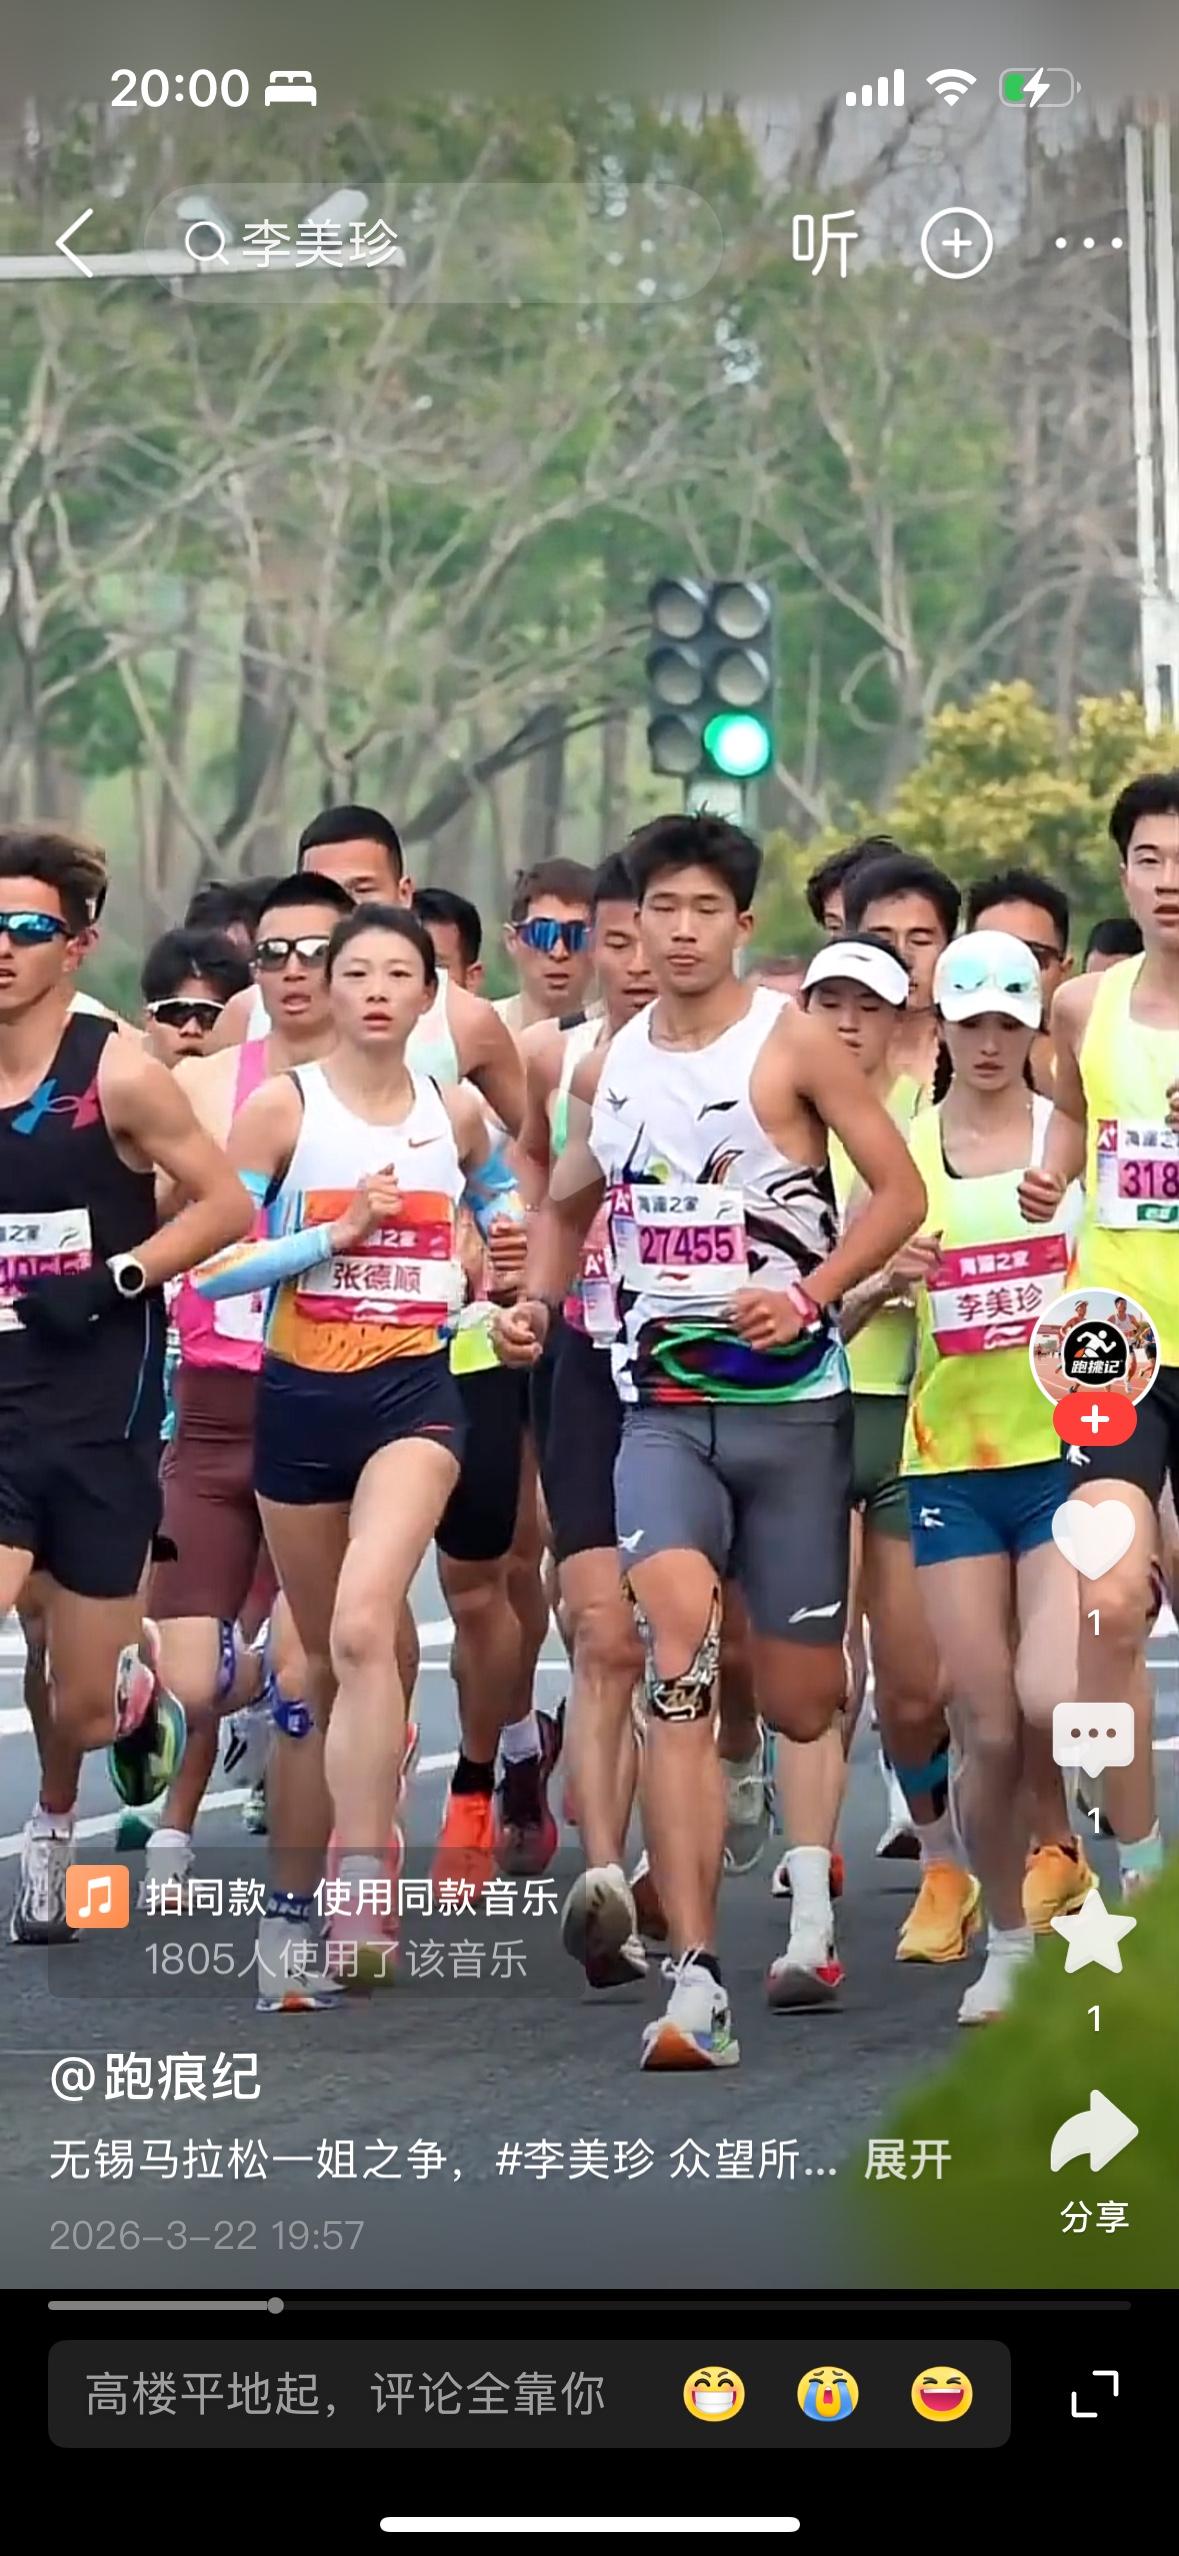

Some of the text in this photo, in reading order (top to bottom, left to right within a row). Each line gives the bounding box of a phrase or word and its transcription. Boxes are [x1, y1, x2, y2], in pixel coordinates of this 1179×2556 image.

[640, 1226, 734, 1265] 27455
[331, 1262, 422, 1294] 张德顺
[956, 1283, 1042, 1322] 李美珍
